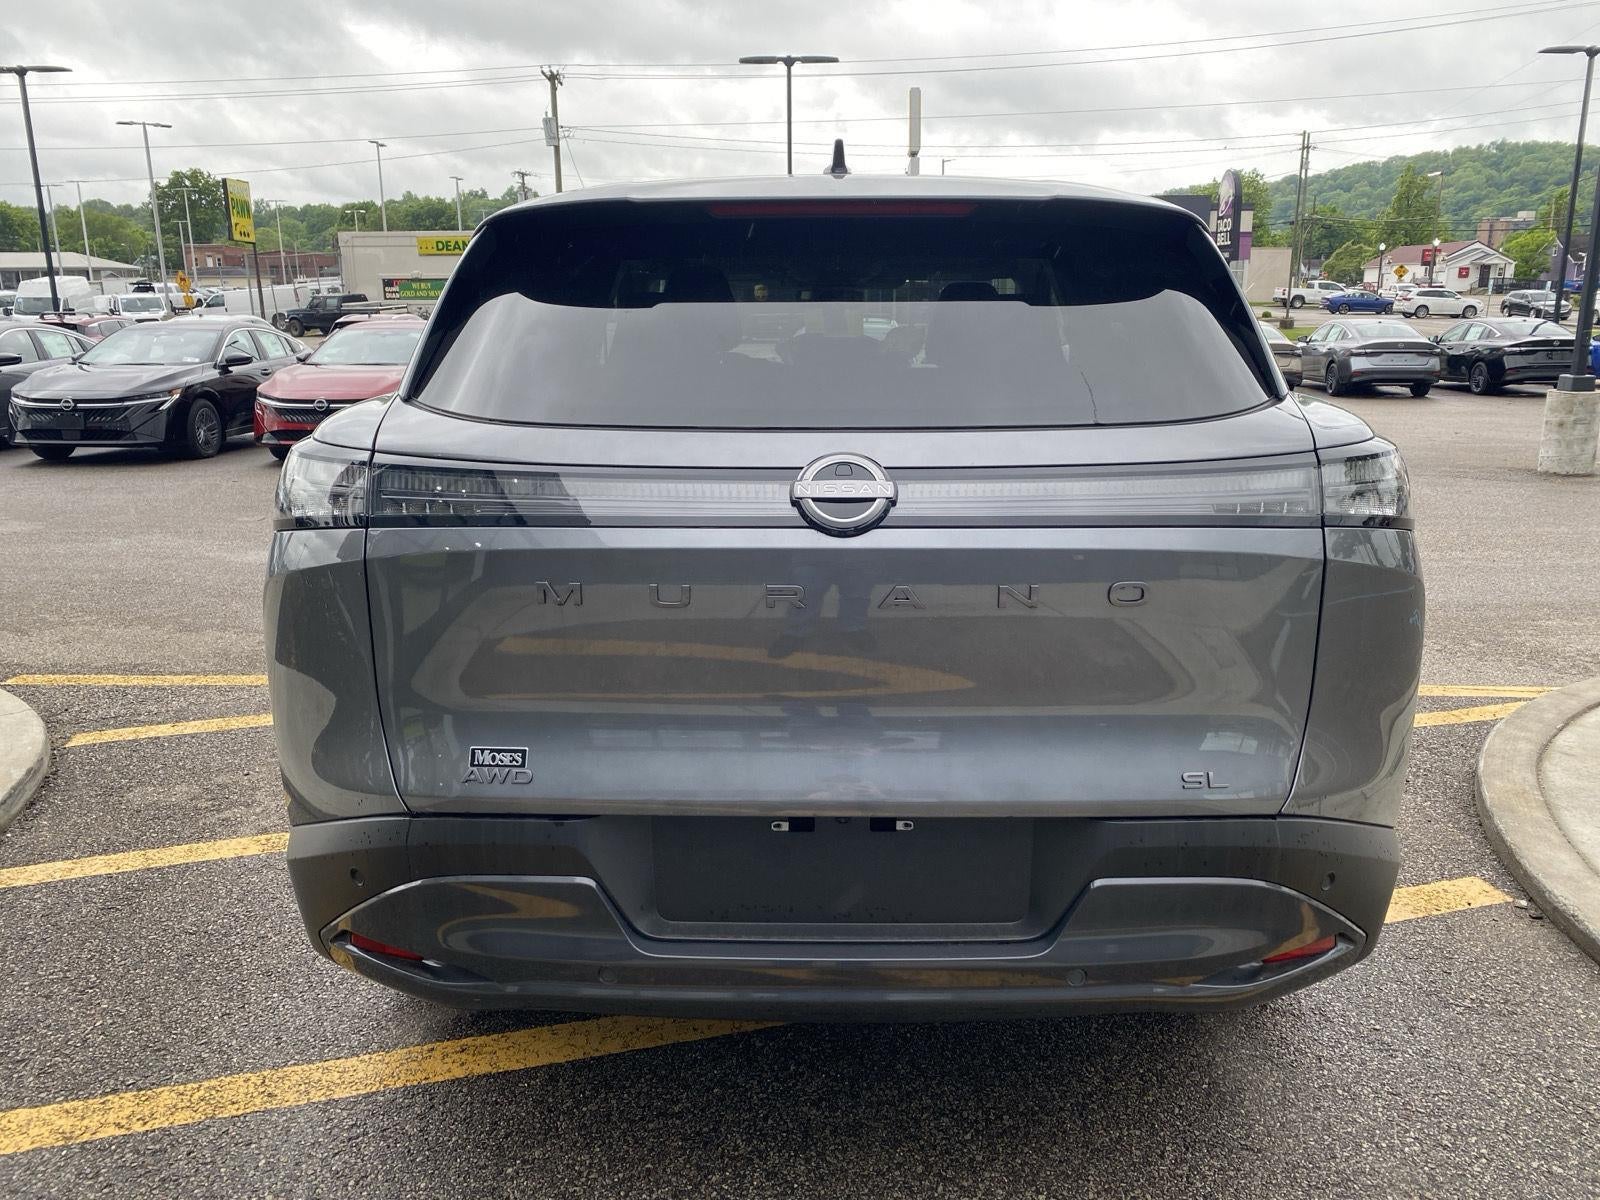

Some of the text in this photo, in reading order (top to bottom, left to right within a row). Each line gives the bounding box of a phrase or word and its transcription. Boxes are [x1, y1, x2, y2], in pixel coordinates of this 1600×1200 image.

[231, 197, 251, 219] PAWN
[1217, 218, 1232, 233] TACO
[1216, 232, 1231, 246] BELL
[400, 289, 441, 298] GOLD AND SILV
[411, 282, 420, 290] WE
[420, 282, 431, 290] BUY
[797, 483, 891, 496] NISSAN
[535, 580, 1150, 609] MURANO
[462, 767, 534, 784] AWD
[1181, 771, 1230, 789] SL
